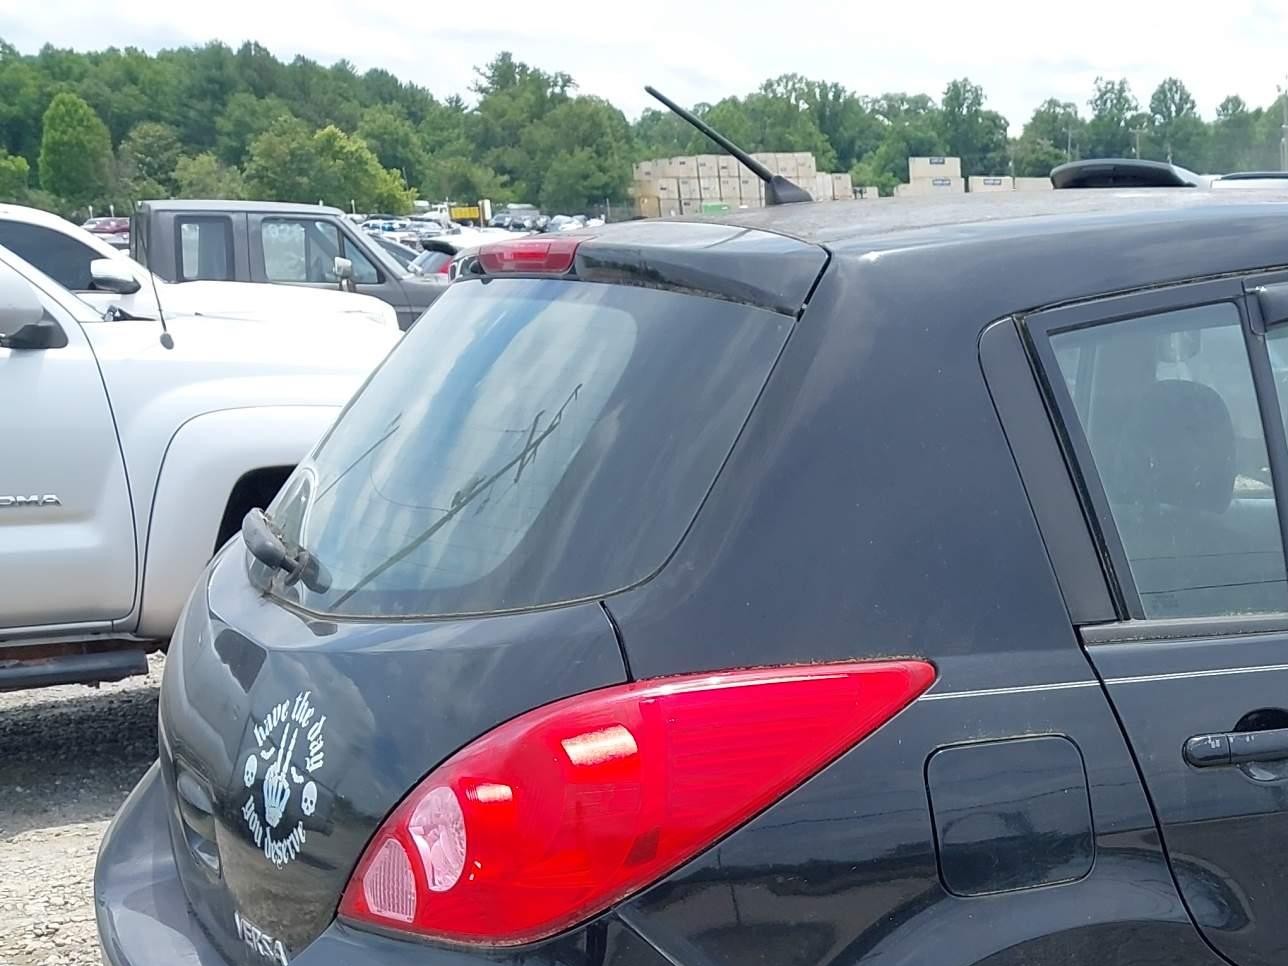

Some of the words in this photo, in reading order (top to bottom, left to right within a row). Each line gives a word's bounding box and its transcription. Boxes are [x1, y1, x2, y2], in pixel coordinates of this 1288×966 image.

[253, 699, 290, 747] have
[291, 691, 316, 727] the
[305, 715, 327, 773] day
[241, 795, 263, 848] you
[264, 820, 307, 870] deserve
[234, 910, 288, 966] VERSA
